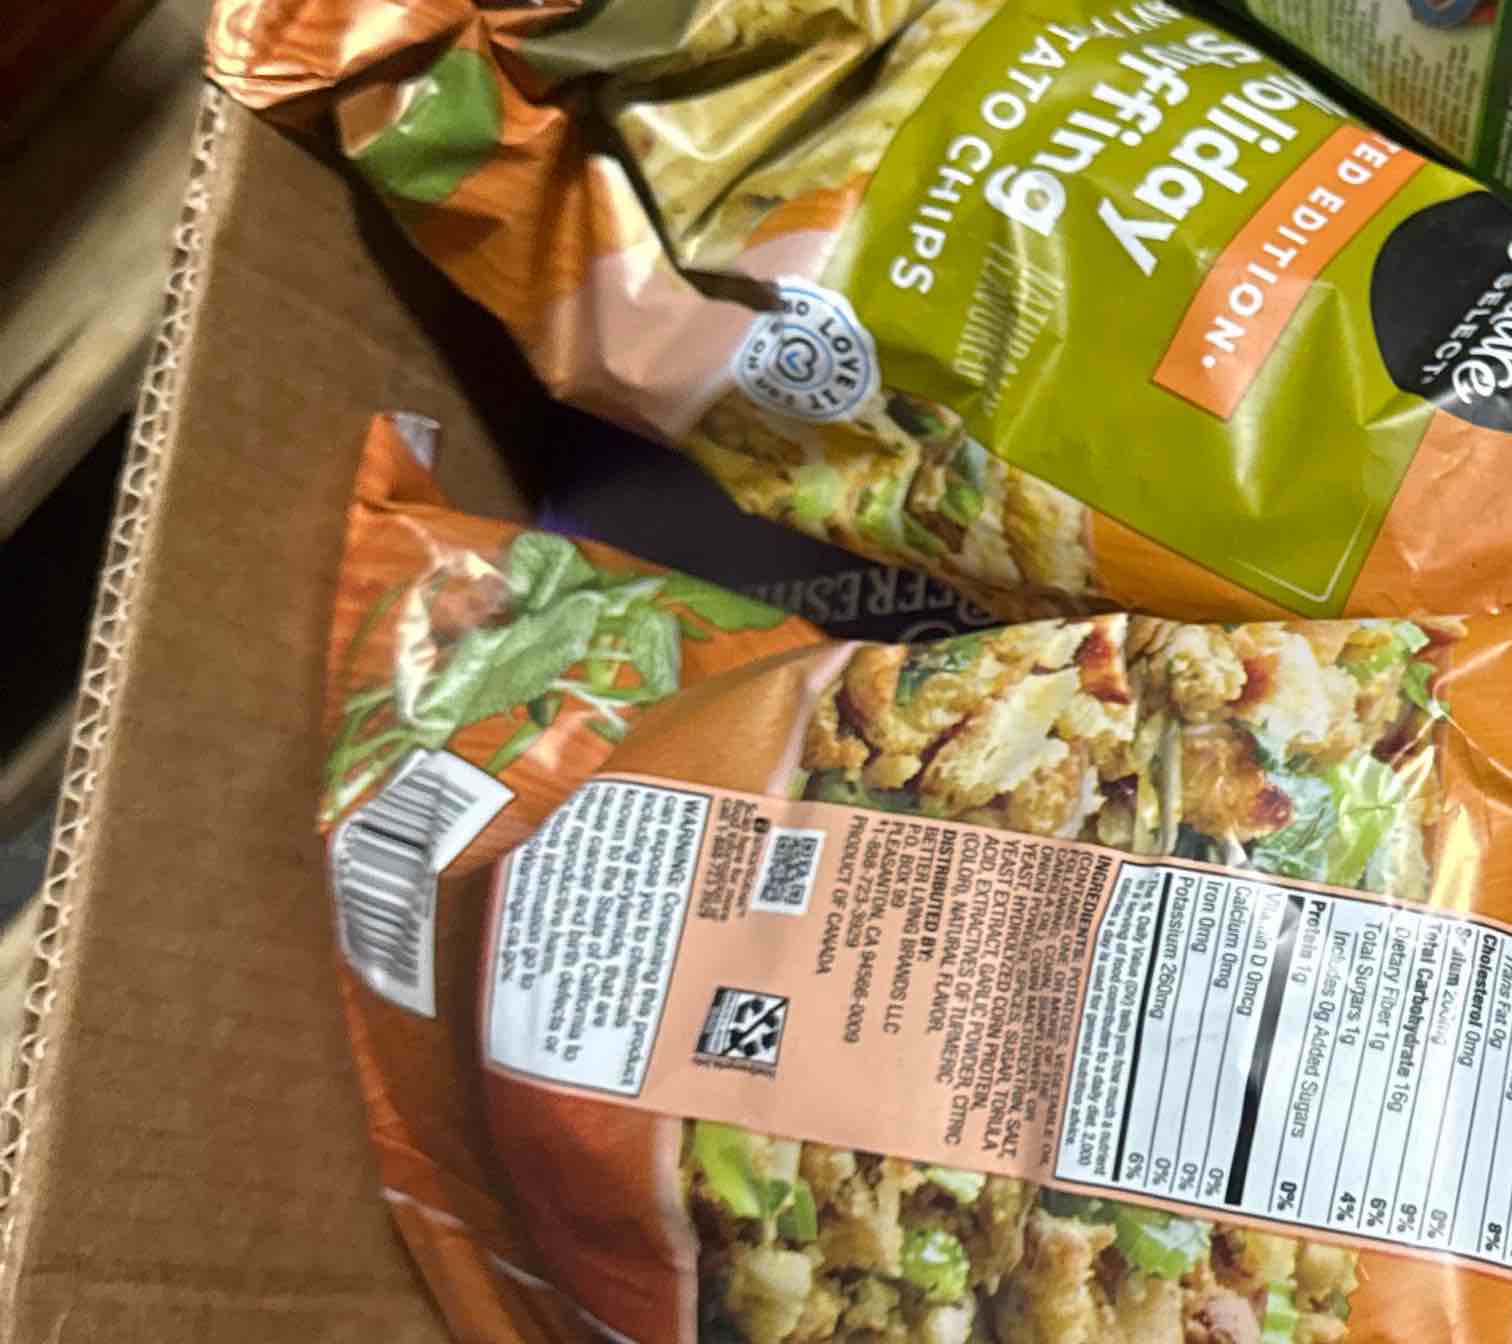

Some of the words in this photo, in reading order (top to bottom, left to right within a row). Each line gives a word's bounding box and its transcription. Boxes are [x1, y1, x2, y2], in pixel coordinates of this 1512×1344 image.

[887, 128, 999, 299] CHIPS
[1204, 188, 1347, 356] EDITION
[921, 828, 957, 934] DISTRIBUTED
[1199, 878, 1222, 915] Iron
[1160, 874, 1194, 961] Potassium
[1223, 884, 1252, 950] Calcium
[1297, 898, 1327, 962] Protein
[1357, 921, 1381, 962] Total
[1147, 960, 1177, 1021] 260mg
[1374, 985, 1399, 1029] Fiber
[1465, 932, 1500, 1029] Cholesterol
[1392, 965, 1434, 1079] Carbohydrate
[1485, 1026, 1506, 1049] 0g
[1492, 1000, 1511, 1026] Fat
[1303, 1024, 1329, 1079] Added
[1455, 1029, 1480, 1068] 0mg
[1288, 1079, 1319, 1140] Sugars
[1385, 1080, 1410, 1114] 16g
[1334, 1190, 1357, 1224] 4%
[1482, 1220, 1502, 1252] 8%
